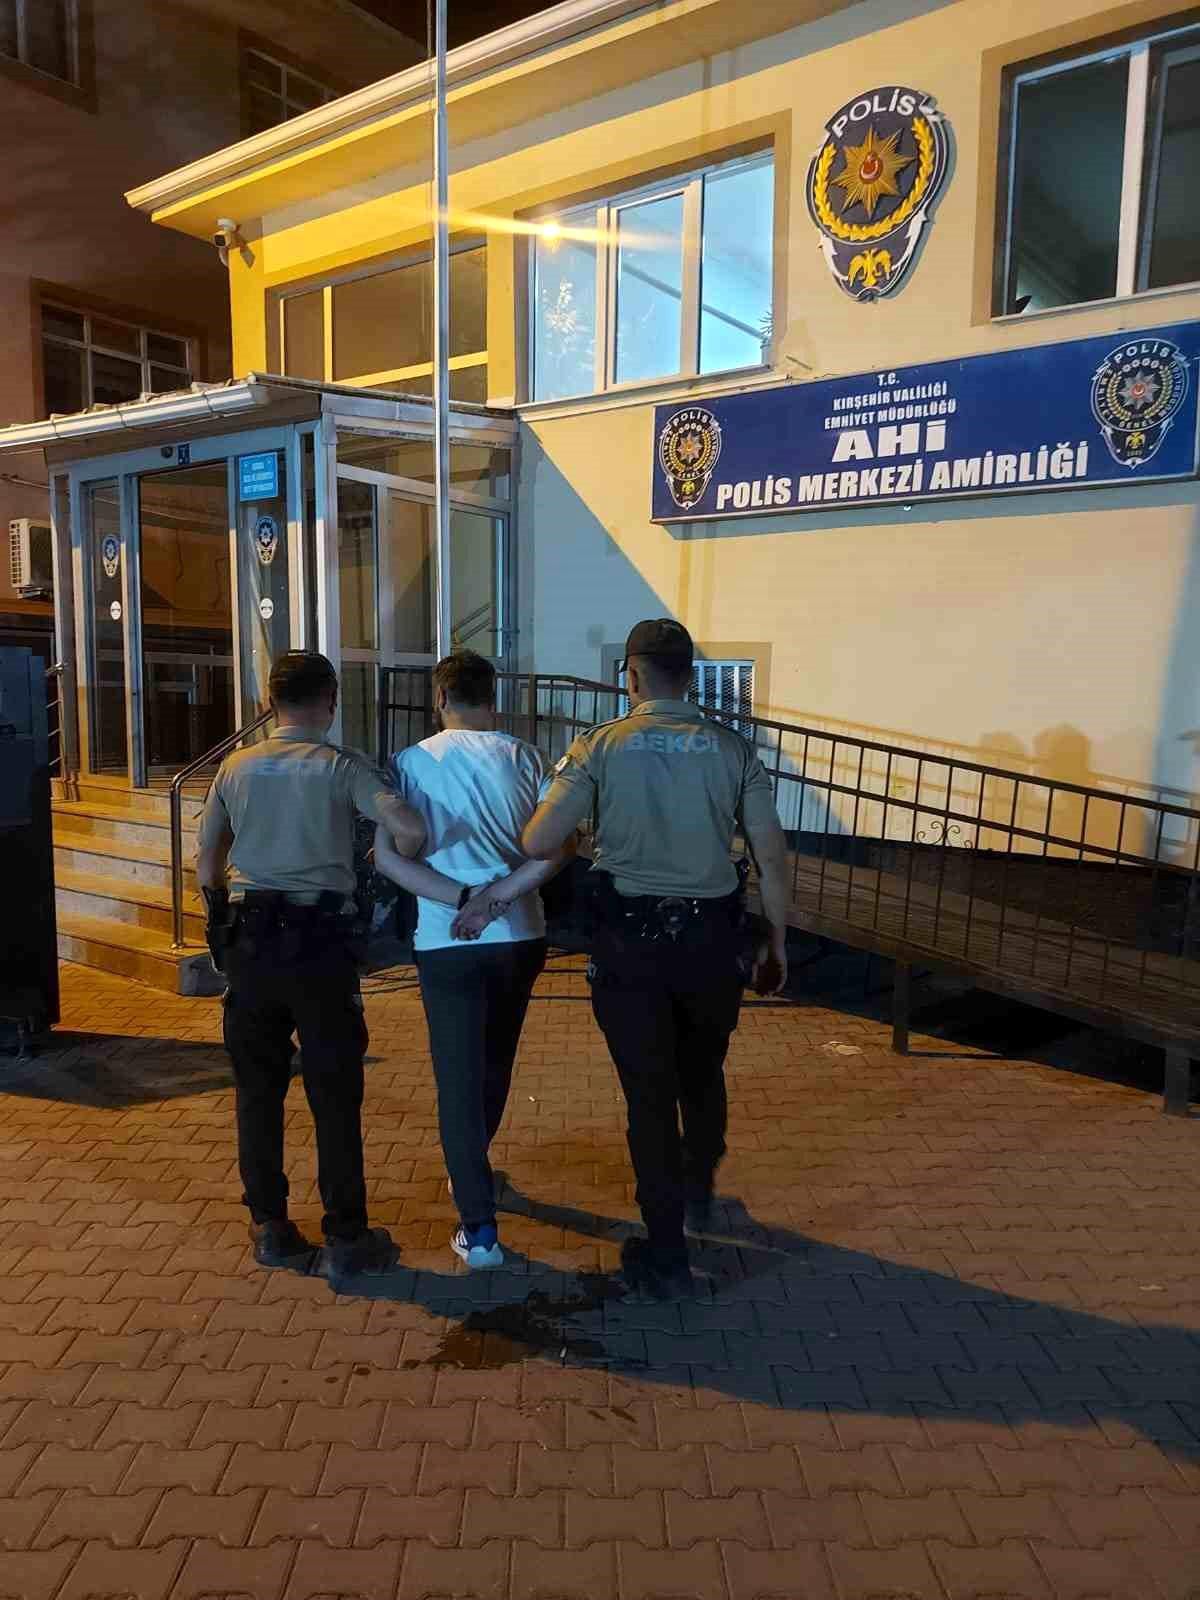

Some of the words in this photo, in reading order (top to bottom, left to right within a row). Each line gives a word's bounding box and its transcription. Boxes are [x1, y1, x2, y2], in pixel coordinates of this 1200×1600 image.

[831, 89, 916, 139] POLİS
[833, 390, 890, 411] KIRŞEHİR
[893, 381, 947, 402] VALİLİĞİ
[877, 372, 900, 386] T.C.
[877, 399, 957, 422] MÜDÜRLÜĞÜ
[832, 420, 946, 462] AHİ
[716, 475, 791, 509] POLİS
[798, 460, 924, 502] MERKEZİ
[929, 440, 1089, 490] AMİRLİĞİ
